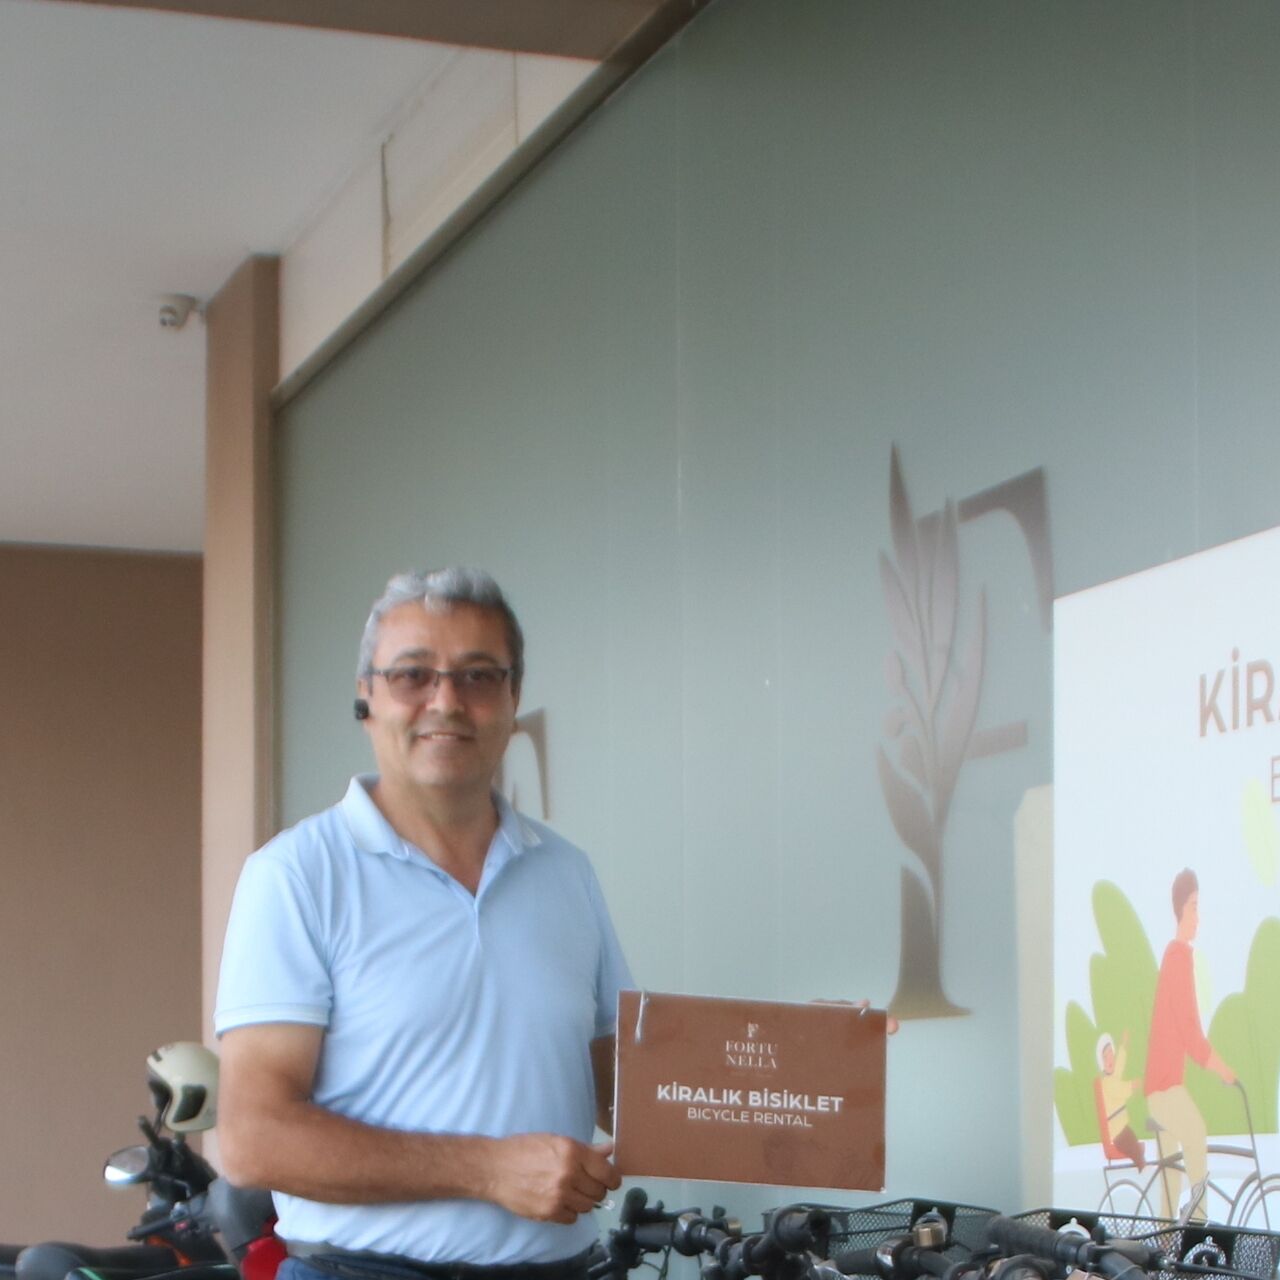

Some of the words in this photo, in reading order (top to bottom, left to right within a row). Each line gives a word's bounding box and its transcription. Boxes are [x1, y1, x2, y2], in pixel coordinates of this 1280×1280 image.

[725, 1040, 778, 1055] FORTU
[725, 1054, 778, 1069] NELLA
[656, 1081, 742, 1105] KİRALIK
[748, 1088, 844, 1112] BİSİKLET
[687, 1107, 750, 1123] BICYCLE
[753, 1112, 813, 1127] RENTAL
